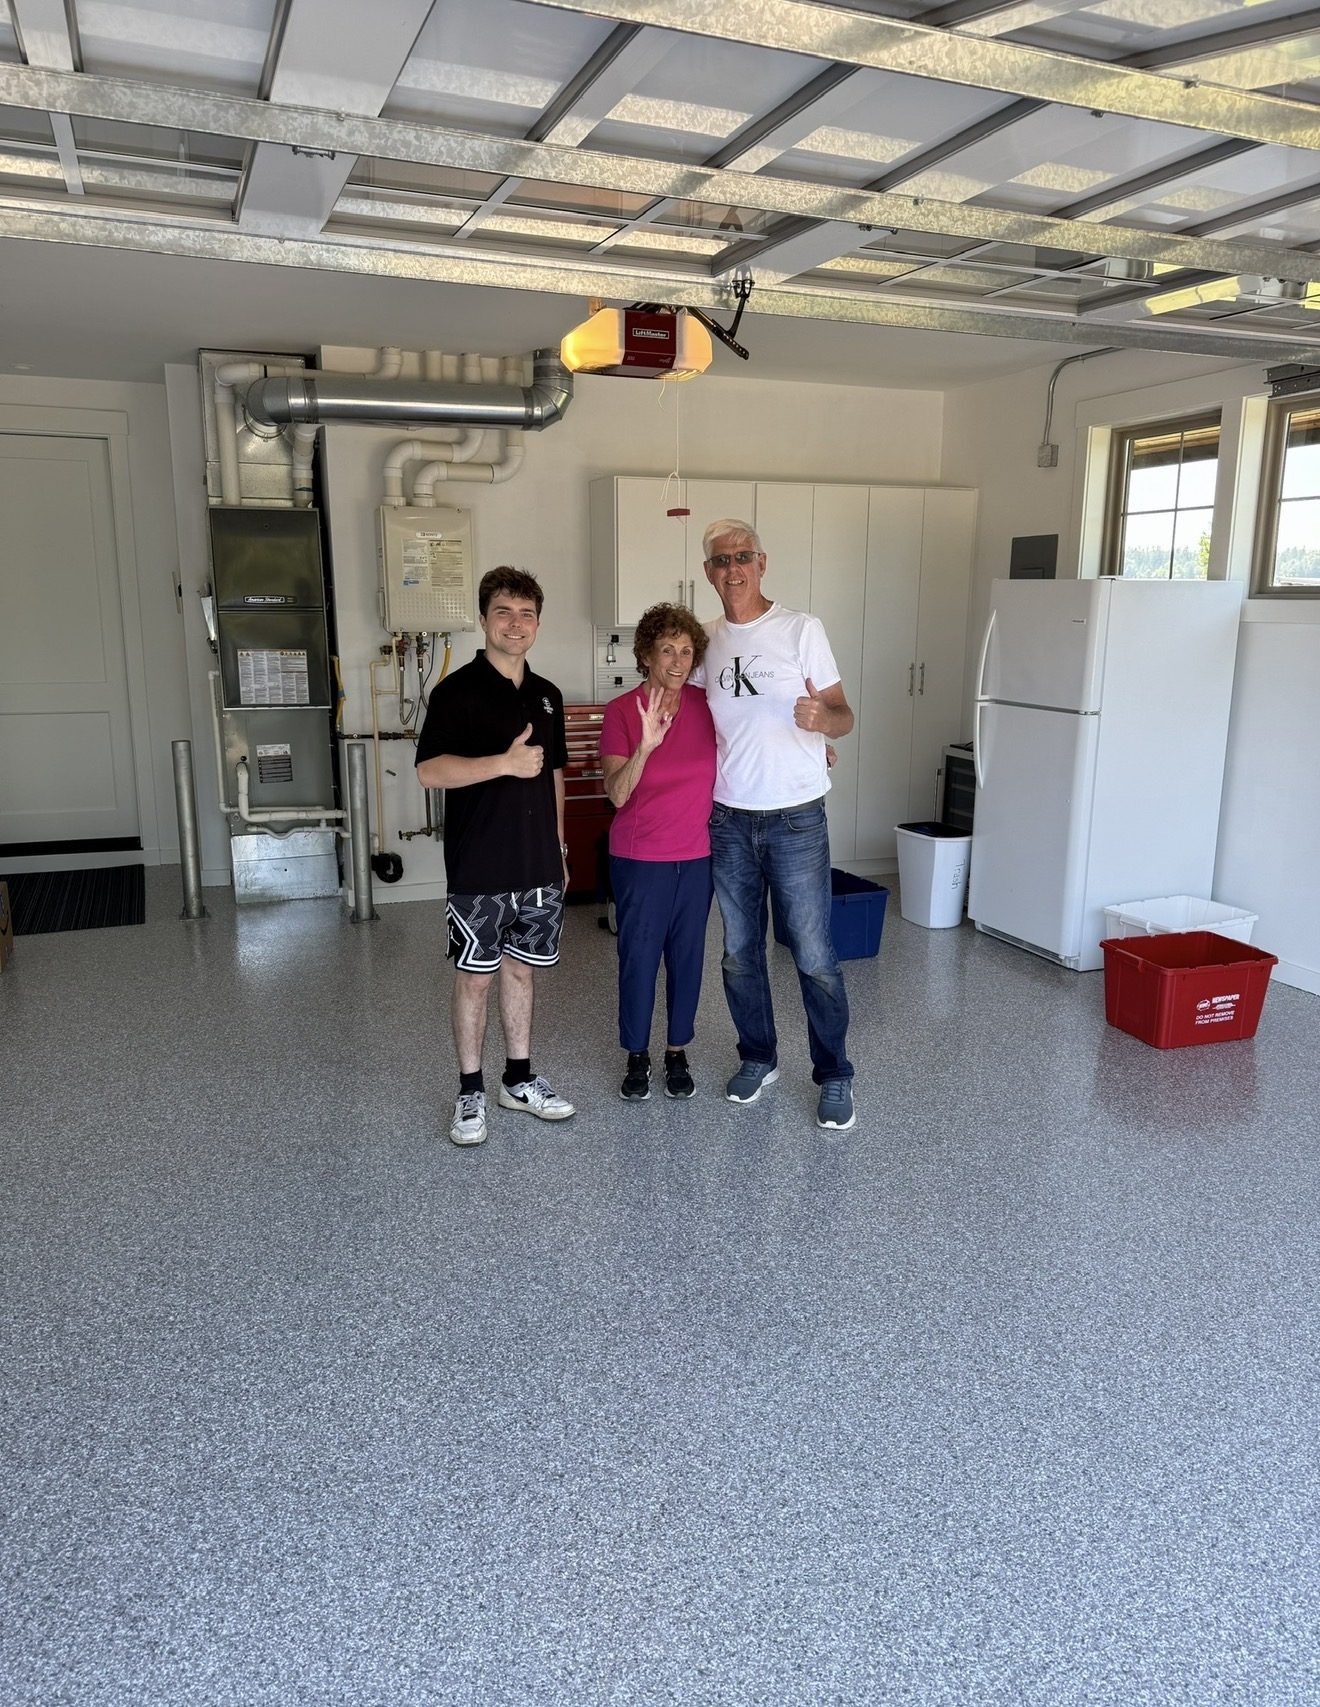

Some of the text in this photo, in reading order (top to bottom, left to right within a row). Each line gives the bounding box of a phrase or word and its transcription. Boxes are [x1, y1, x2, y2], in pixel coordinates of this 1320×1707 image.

[720, 655, 765, 698] CK
[751, 671, 775, 679] JEANS
[951, 858, 966, 890] Trash
[1212, 994, 1240, 1004] NEWSPAPER
[1215, 1010, 1235, 1018] REMOVE
[1210, 1015, 1234, 1024] PREMISES
